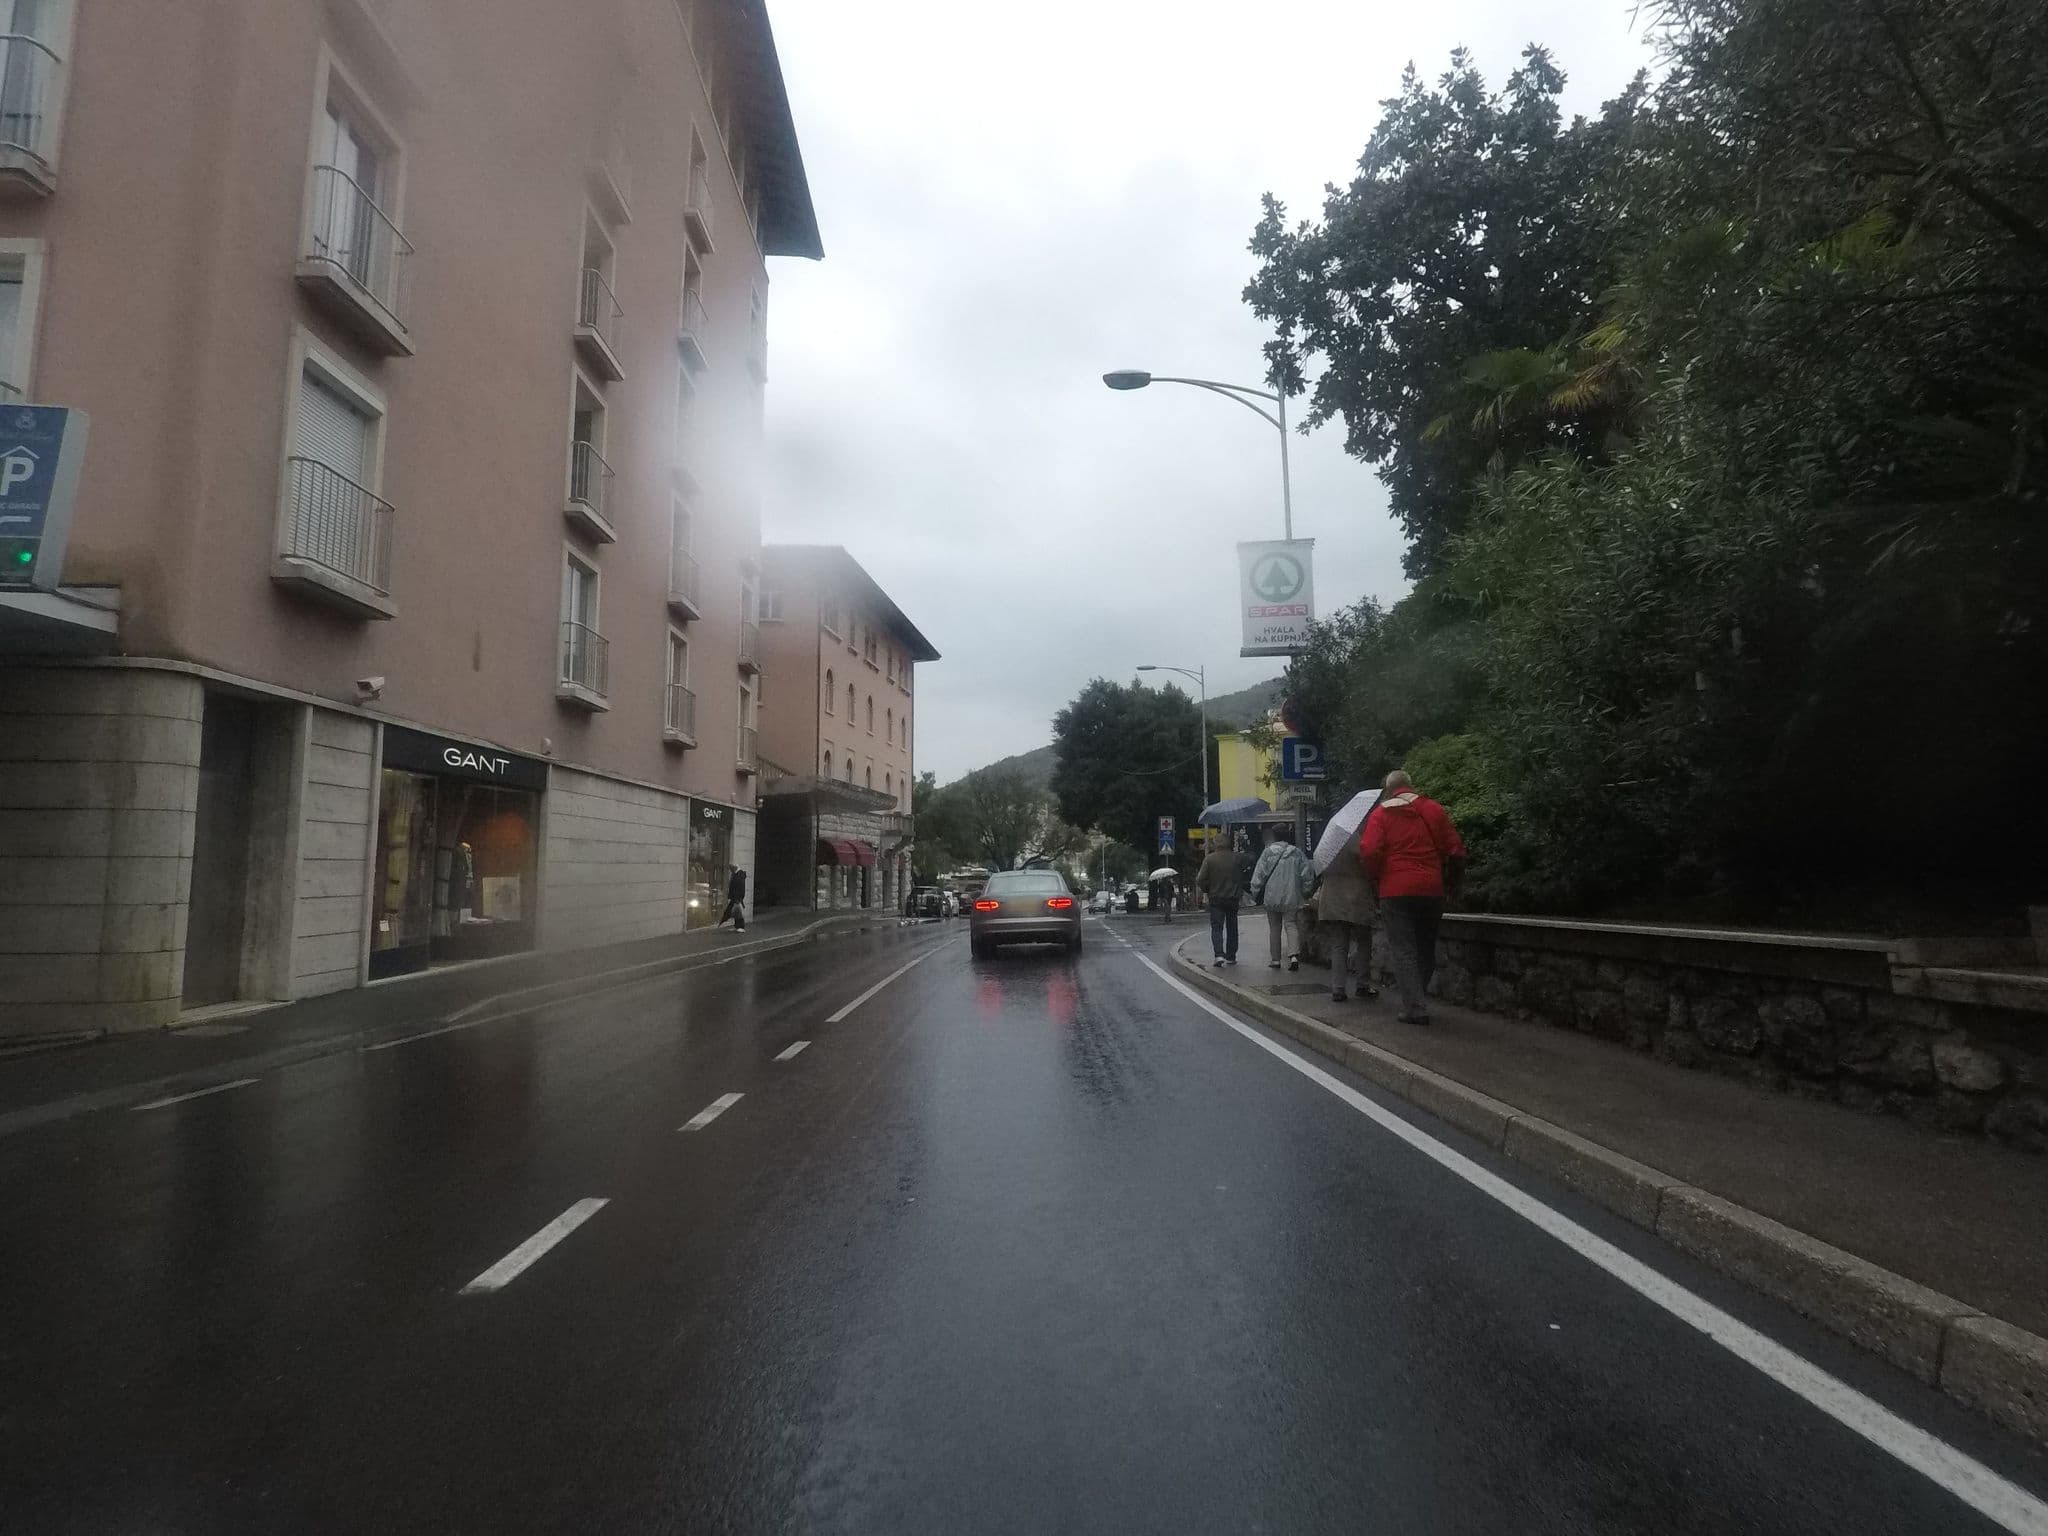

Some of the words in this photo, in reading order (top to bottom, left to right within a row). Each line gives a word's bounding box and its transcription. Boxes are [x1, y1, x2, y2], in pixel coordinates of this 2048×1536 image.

[0, 456, 34, 496] P
[1249, 606, 1306, 616] SPAR
[1264, 626, 1295, 634] HVALA
[1255, 635, 1268, 643] NA
[443, 748, 510, 775] GANT
[1294, 744, 1318, 773] P
[704, 808, 722, 818] GANT
